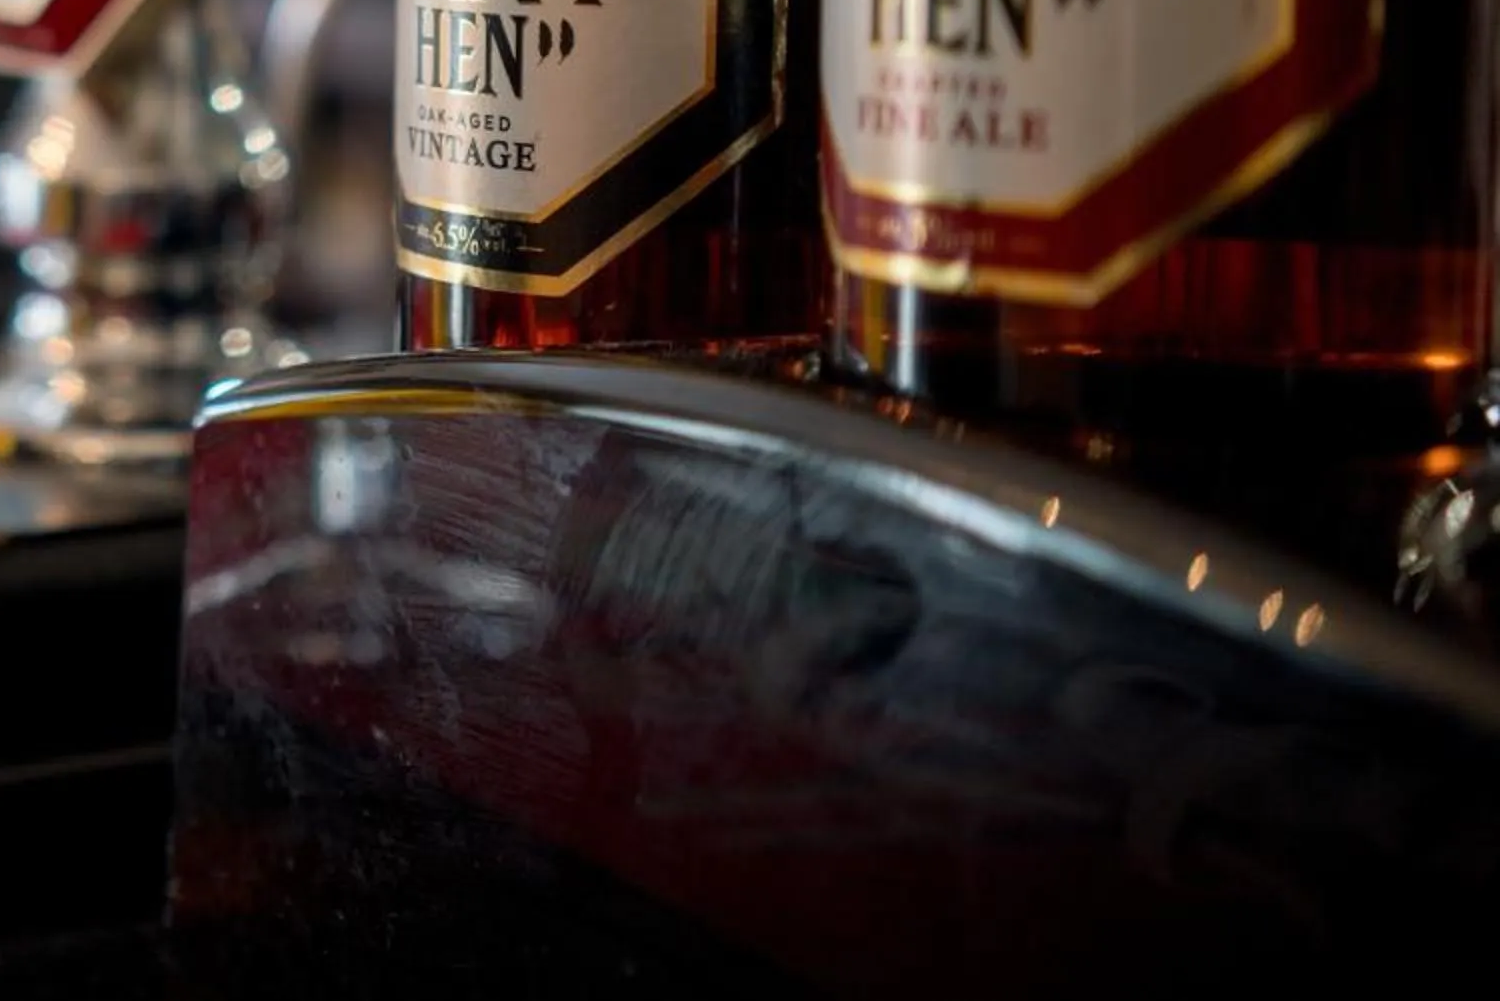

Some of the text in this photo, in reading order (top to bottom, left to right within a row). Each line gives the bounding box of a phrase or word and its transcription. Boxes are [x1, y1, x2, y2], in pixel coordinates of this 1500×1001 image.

[418, 104, 512, 133] OAK-AGED
[950, 105, 1050, 153] ALE
[408, 126, 538, 172] VINTAGE
